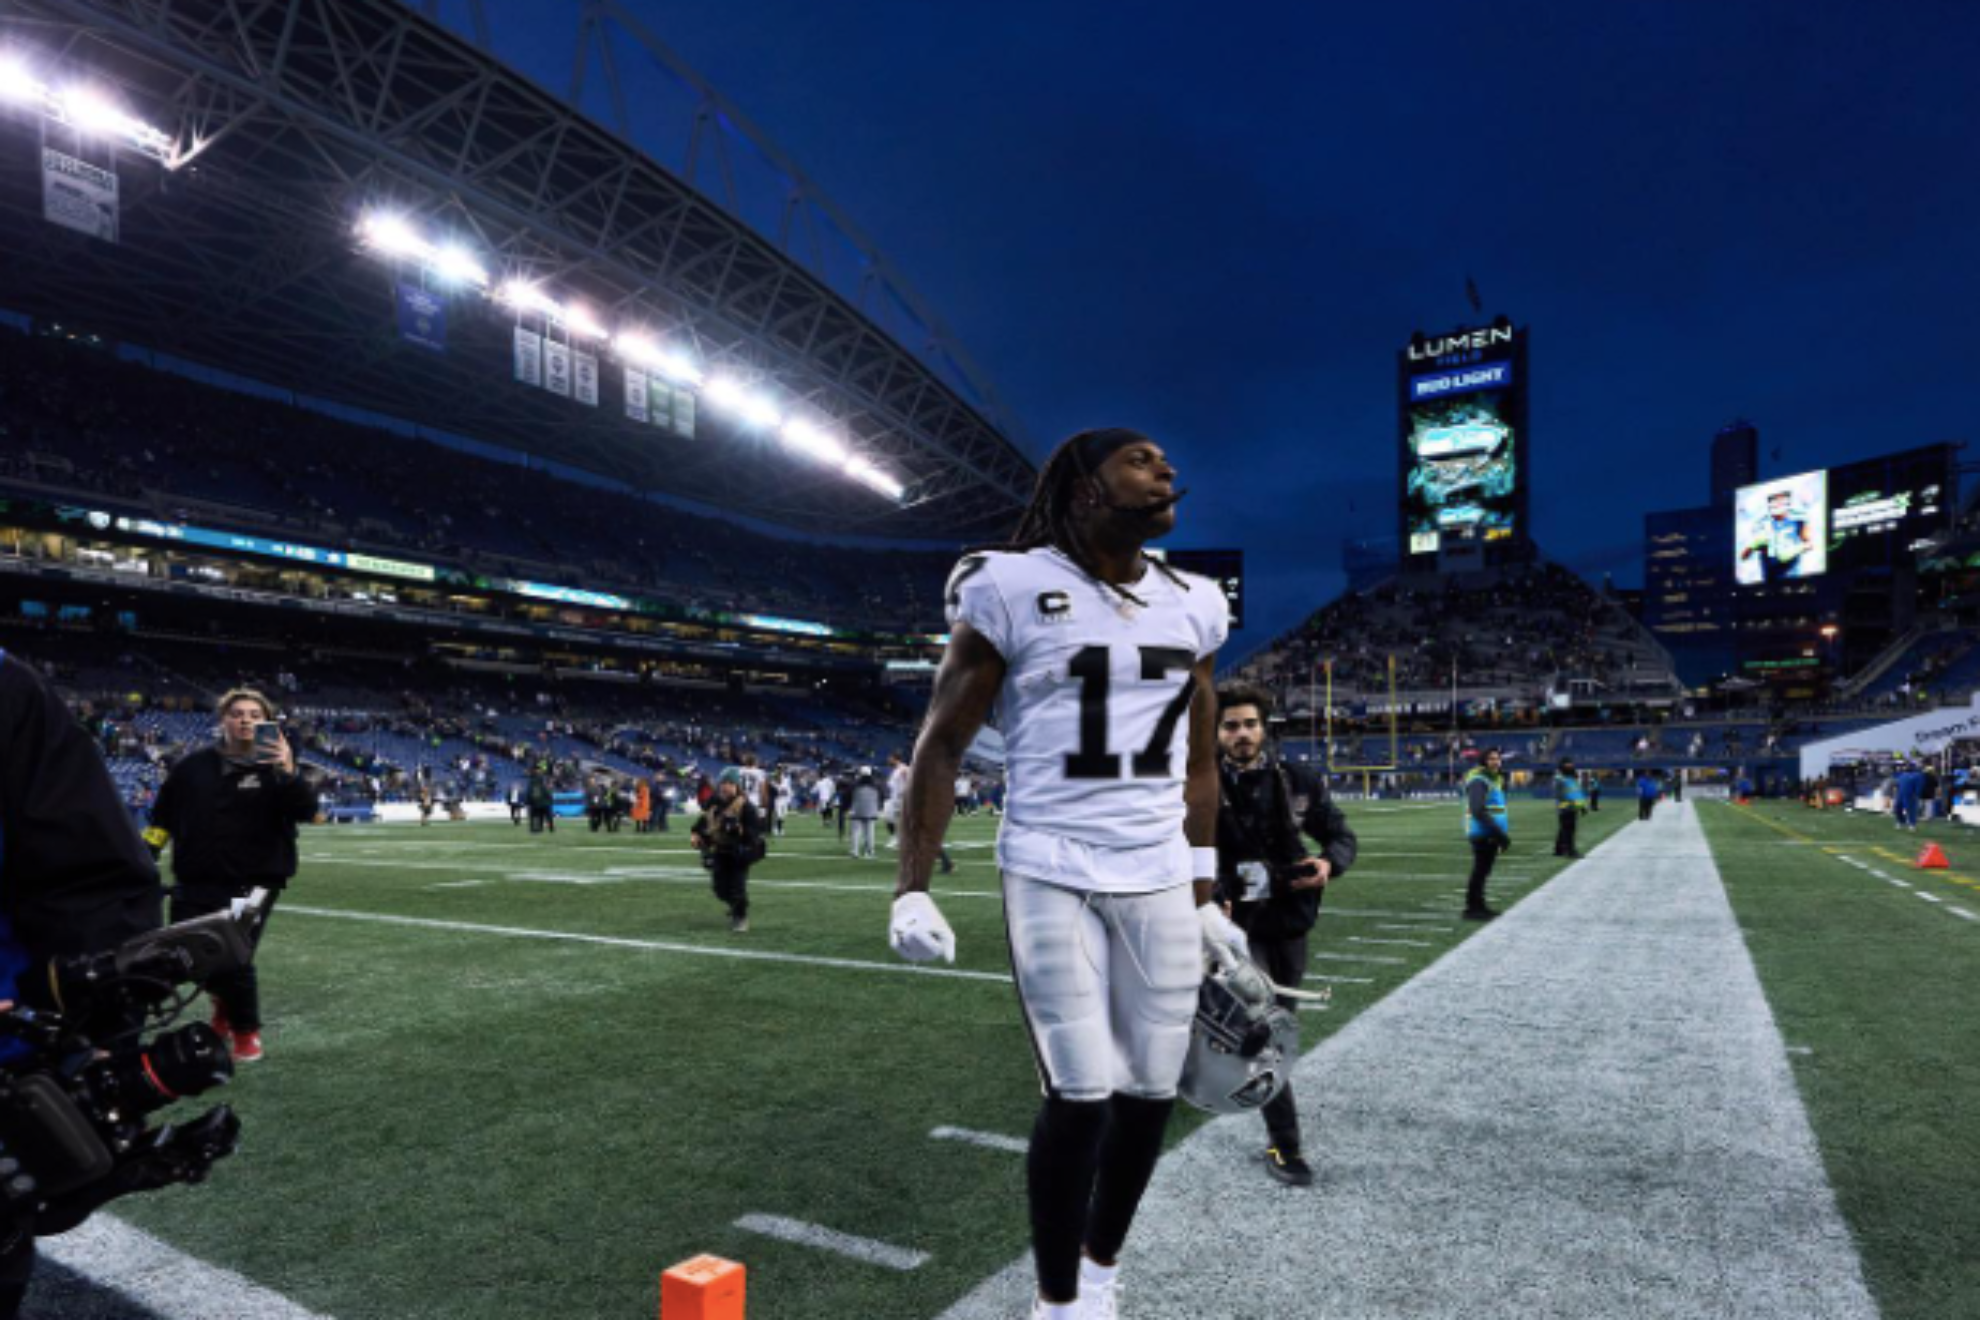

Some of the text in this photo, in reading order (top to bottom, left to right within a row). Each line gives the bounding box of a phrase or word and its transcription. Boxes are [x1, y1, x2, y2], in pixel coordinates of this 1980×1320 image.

[1407, 325, 1512, 360] LUMEN
[1451, 367, 1504, 387] LIGHT
[1037, 591, 1070, 615] C
[1064, 643, 1198, 778] 17
